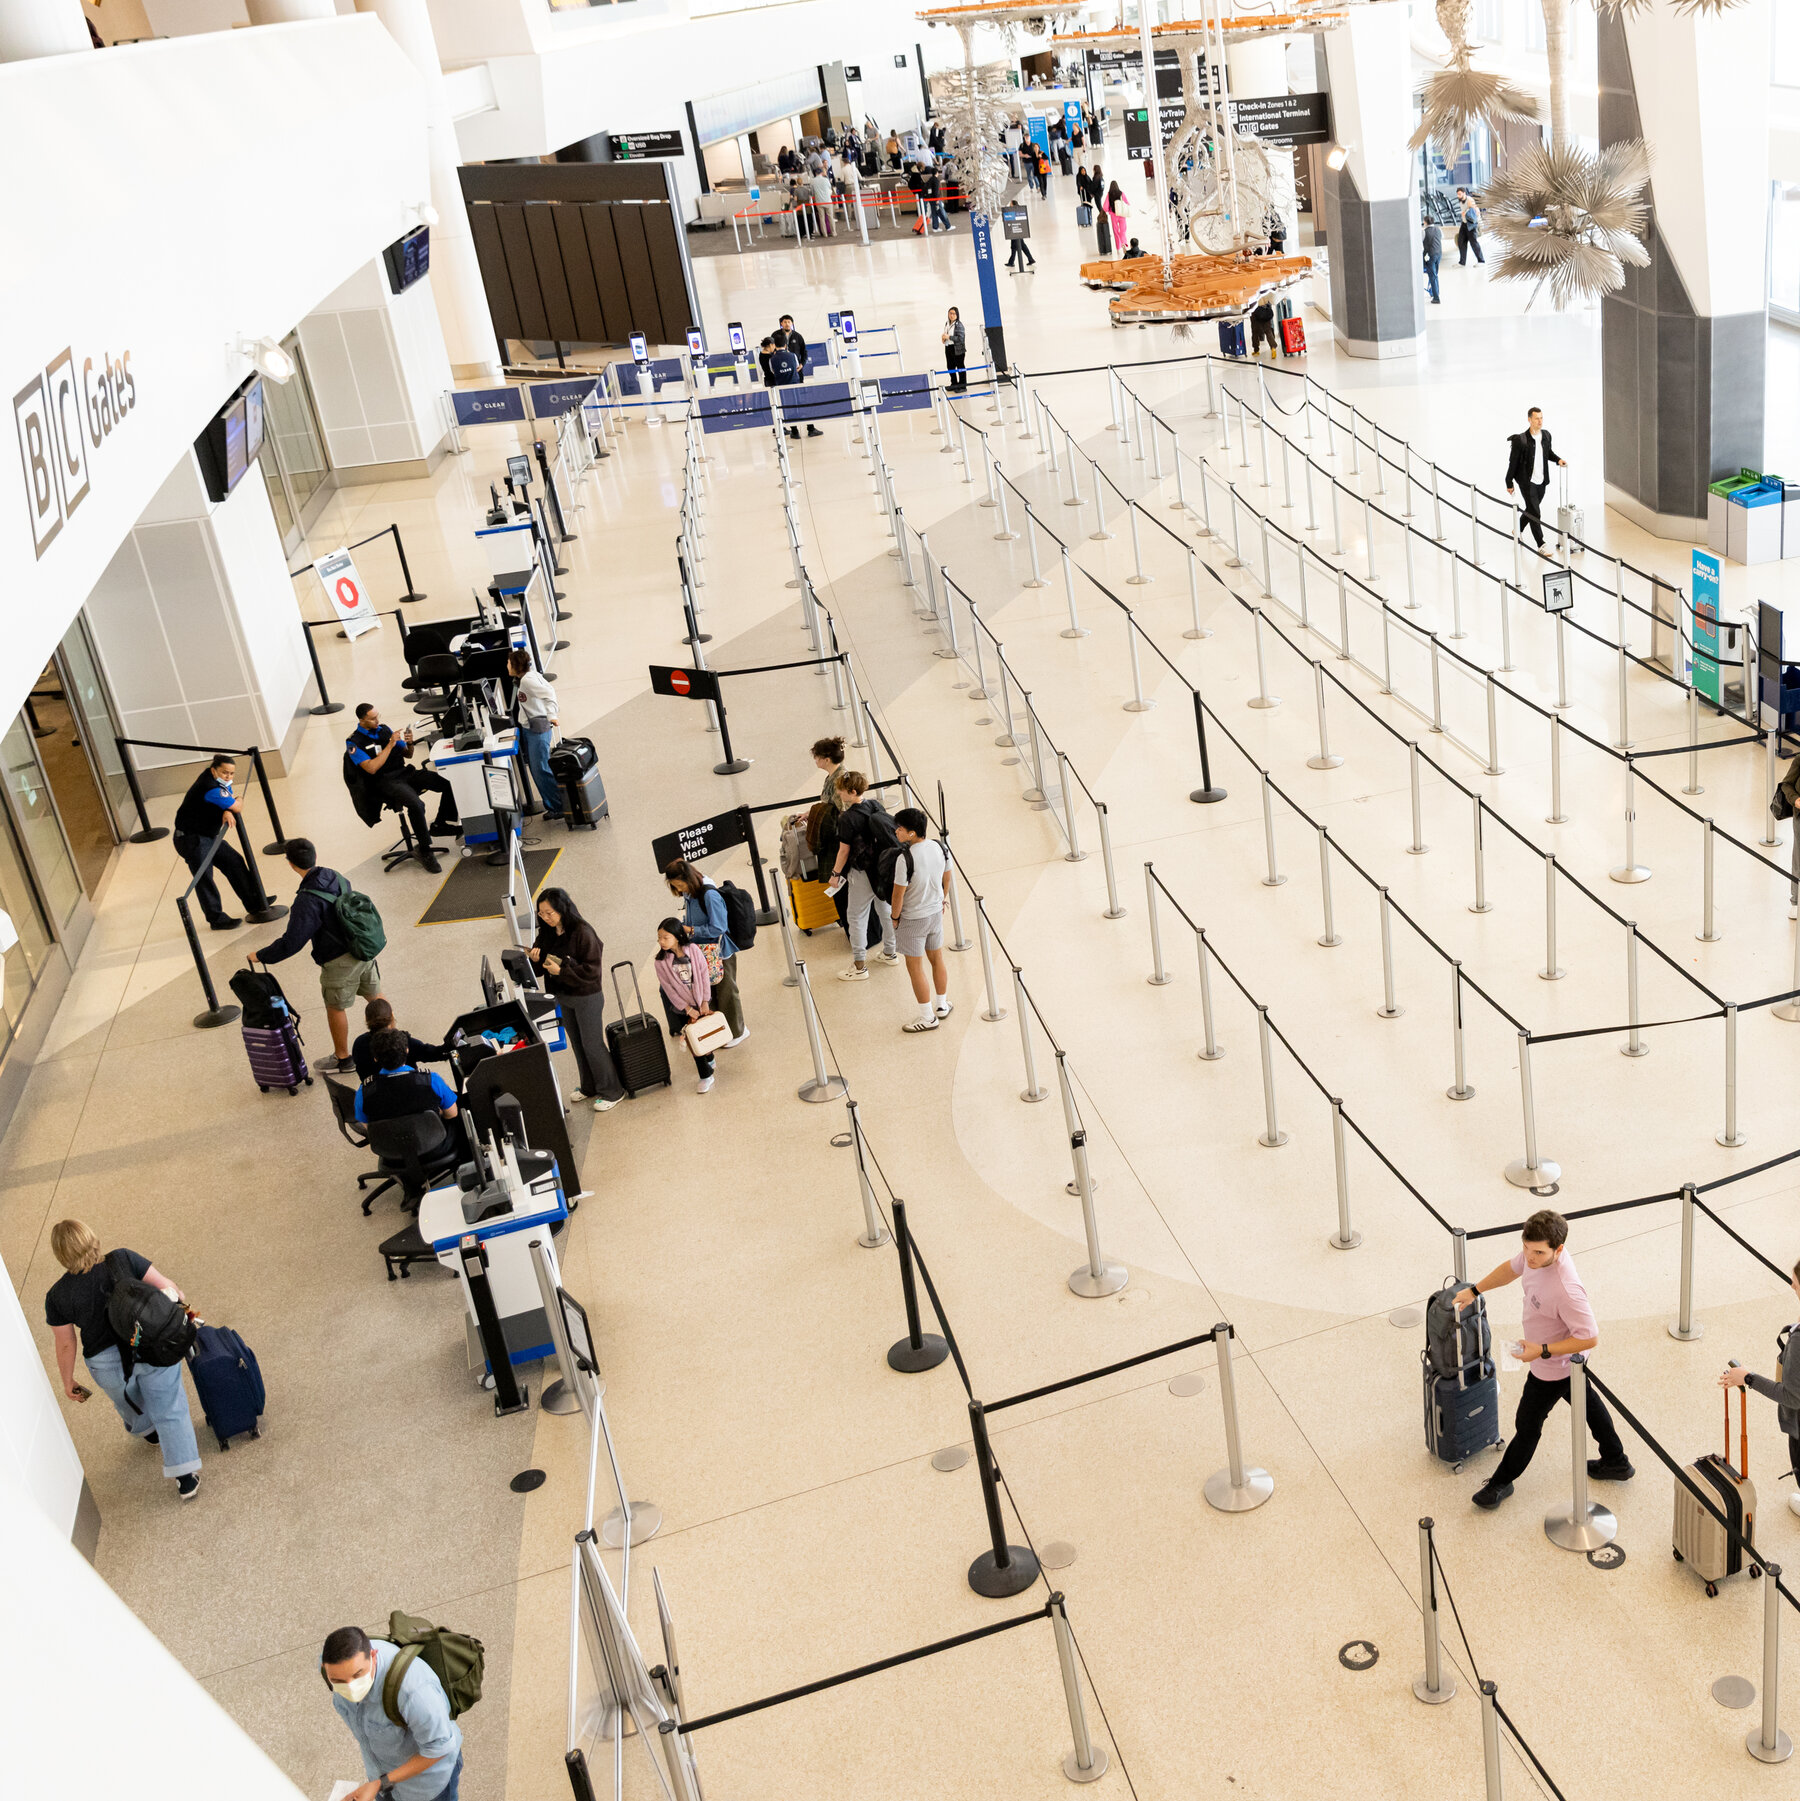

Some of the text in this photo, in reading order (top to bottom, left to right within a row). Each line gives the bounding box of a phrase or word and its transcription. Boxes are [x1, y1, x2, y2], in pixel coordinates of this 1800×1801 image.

[1267, 101, 1284, 109] Zones
[1293, 99, 1297, 107] 2
[1160, 110, 1185, 118] AirTrain
[1239, 108, 1311, 122] International Terminal
[1160, 120, 1175, 130] Lyft
[1174, 120, 1180, 128] &
[1260, 123, 1279, 131] Gates
[978, 231, 988, 260] CLEAR
[561, 393, 583, 402] CLEAR
[484, 401, 505, 409] CLEAR
[25, 411, 51, 519] B
[58, 378, 80, 477] C
[83, 349, 136, 449] Gates
[1696, 560, 1716, 576] Have a
[678, 823, 714, 842] Please
[680, 836, 705, 852] Wait
[683, 847, 708, 862] Here
